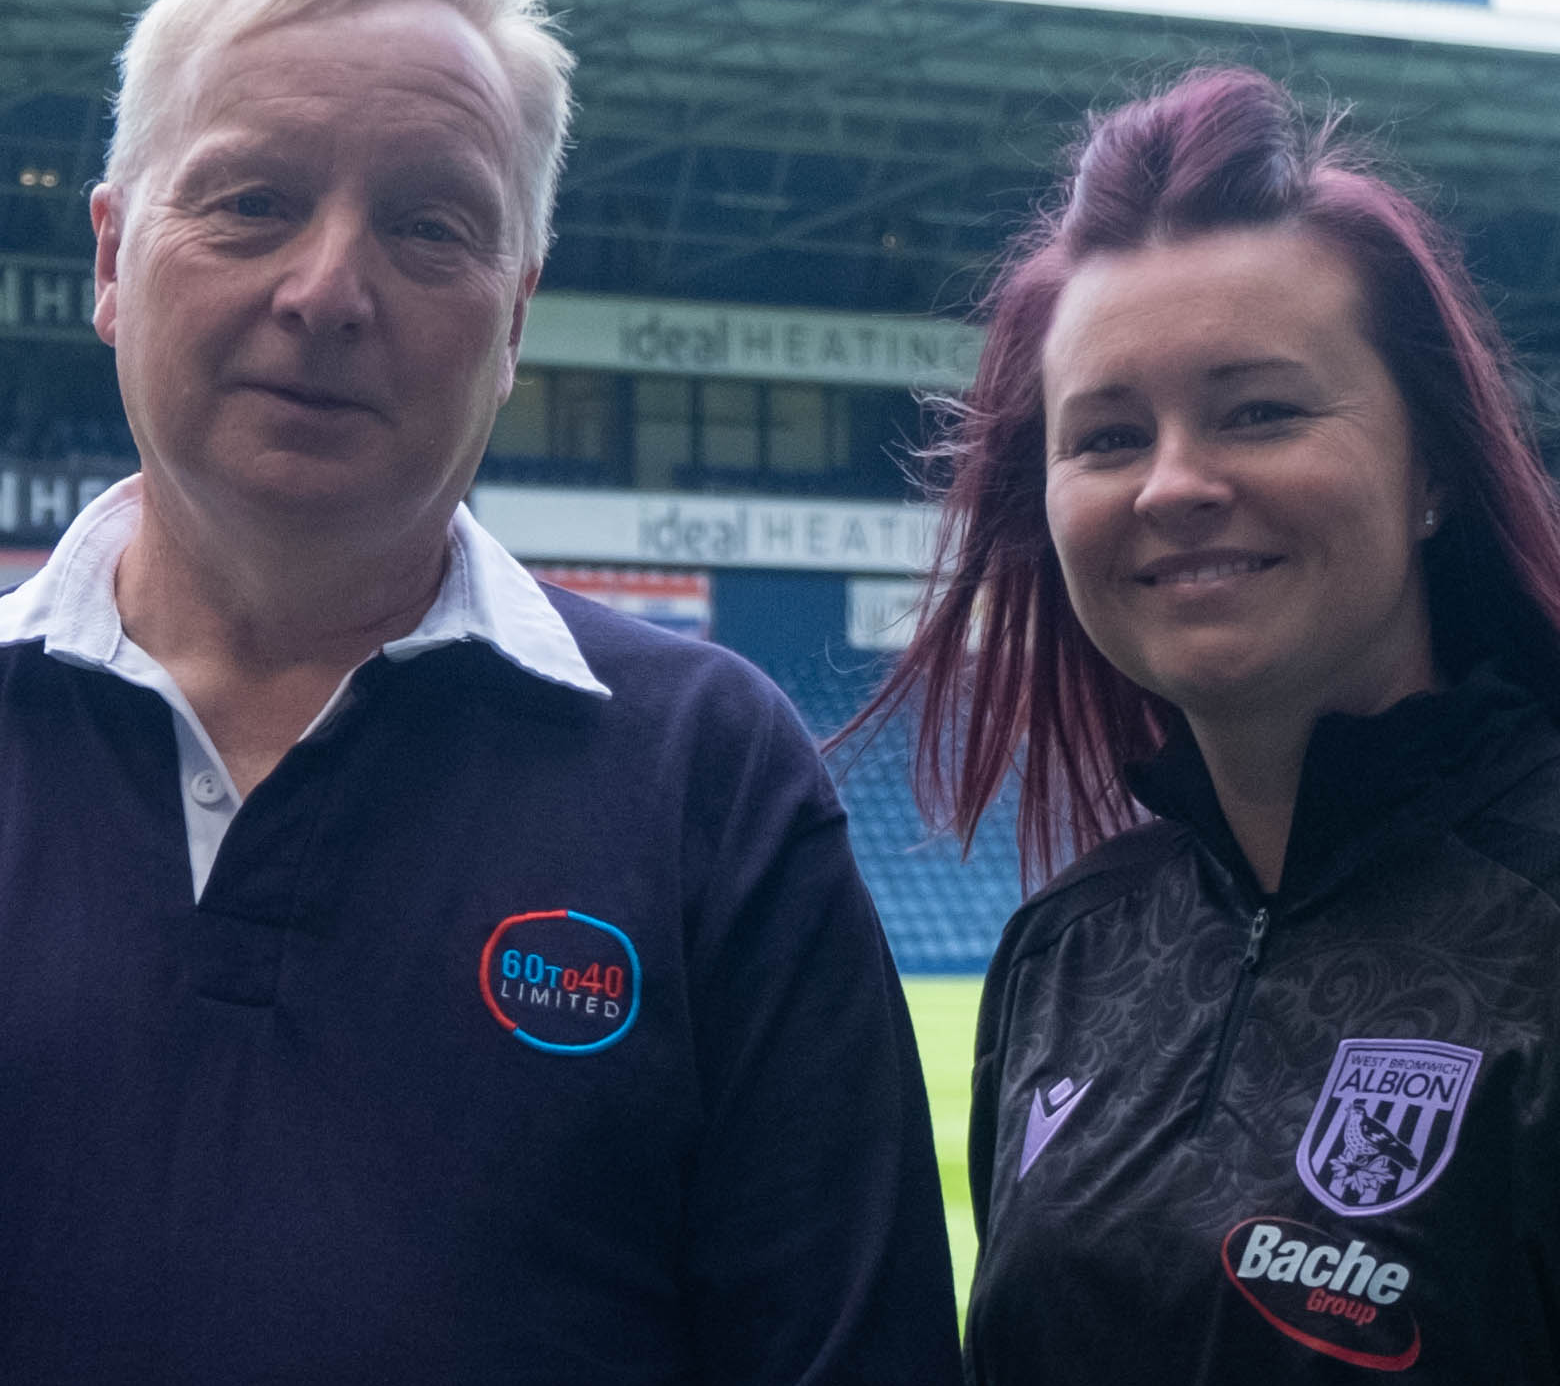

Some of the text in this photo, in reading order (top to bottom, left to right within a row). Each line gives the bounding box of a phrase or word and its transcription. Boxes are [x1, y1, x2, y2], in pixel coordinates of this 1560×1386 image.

[621, 311, 729, 364] ideal
[640, 503, 748, 560] ideal
[500, 980, 620, 1018] LIMITED
[1351, 1054, 1463, 1075] WEST BROMWICH
[1338, 1067, 1457, 1103] ALBION
[1236, 1223, 1411, 1305] Bache
[1306, 1287, 1377, 1326] Group
